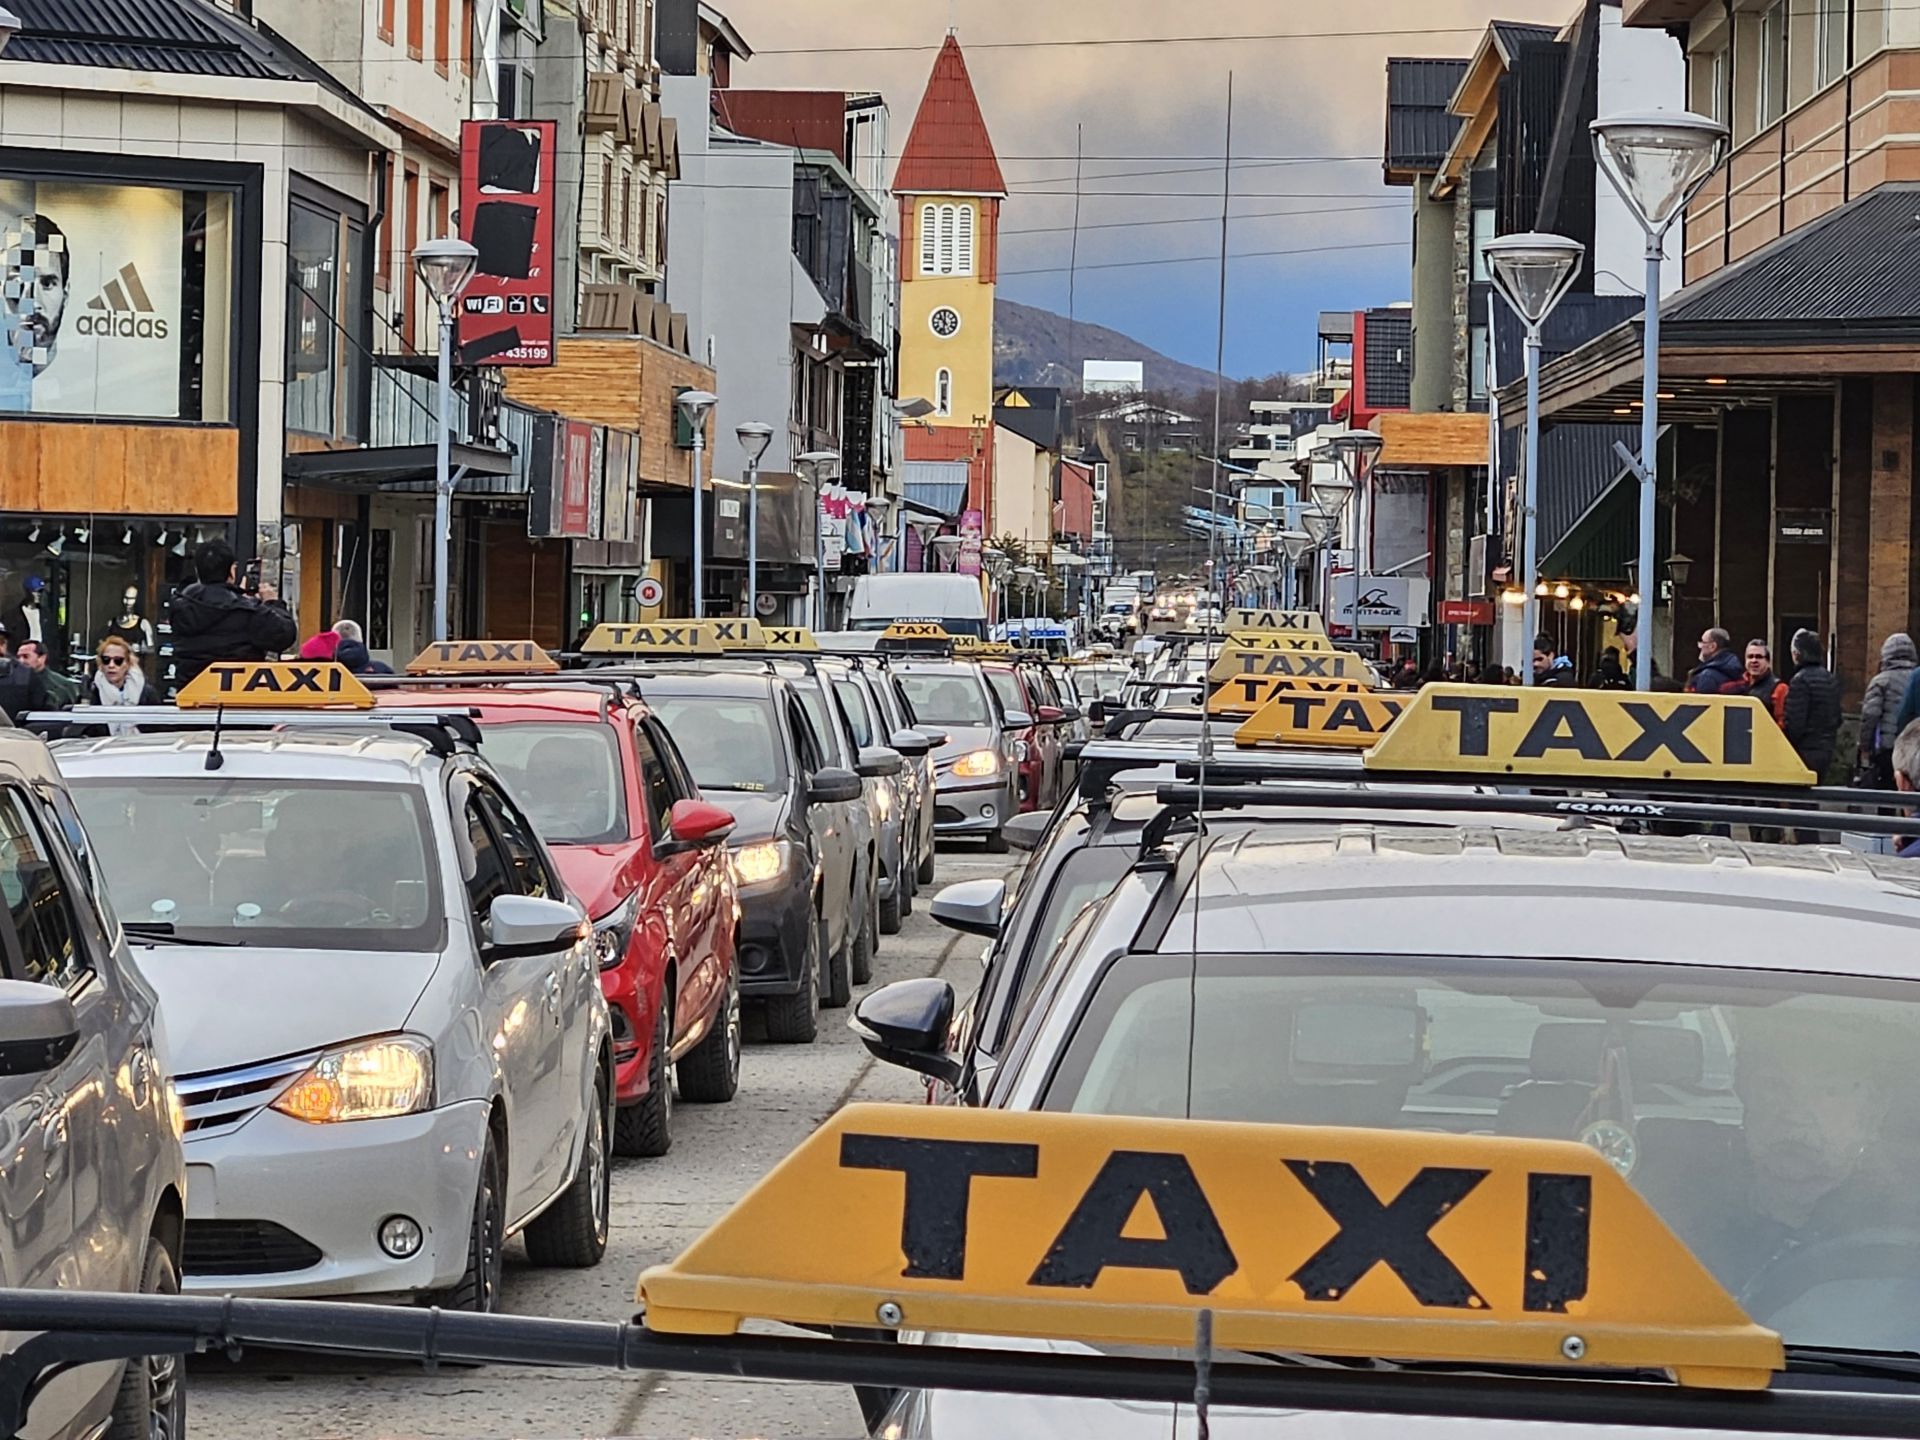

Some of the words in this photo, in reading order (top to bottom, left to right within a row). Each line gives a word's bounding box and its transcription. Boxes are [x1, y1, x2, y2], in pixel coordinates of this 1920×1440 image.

[76, 309, 168, 340] adidas
[506, 347, 548, 359] 435199
[1238, 611, 1310, 629] TAXI
[1343, 608, 1401, 616] MNTAGNE
[607, 628, 698, 646] TAXI
[714, 623, 748, 640] XI
[764, 630, 801, 644] XI
[892, 625, 938, 635] TAXI
[432, 642, 534, 662] TAXI
[1235, 653, 1345, 678] TAXI
[210, 667, 342, 692] TAXI
[1278, 696, 1404, 733] TAX
[1431, 695, 1753, 765] TAXI
[839, 1132, 1593, 1314] TAXI
